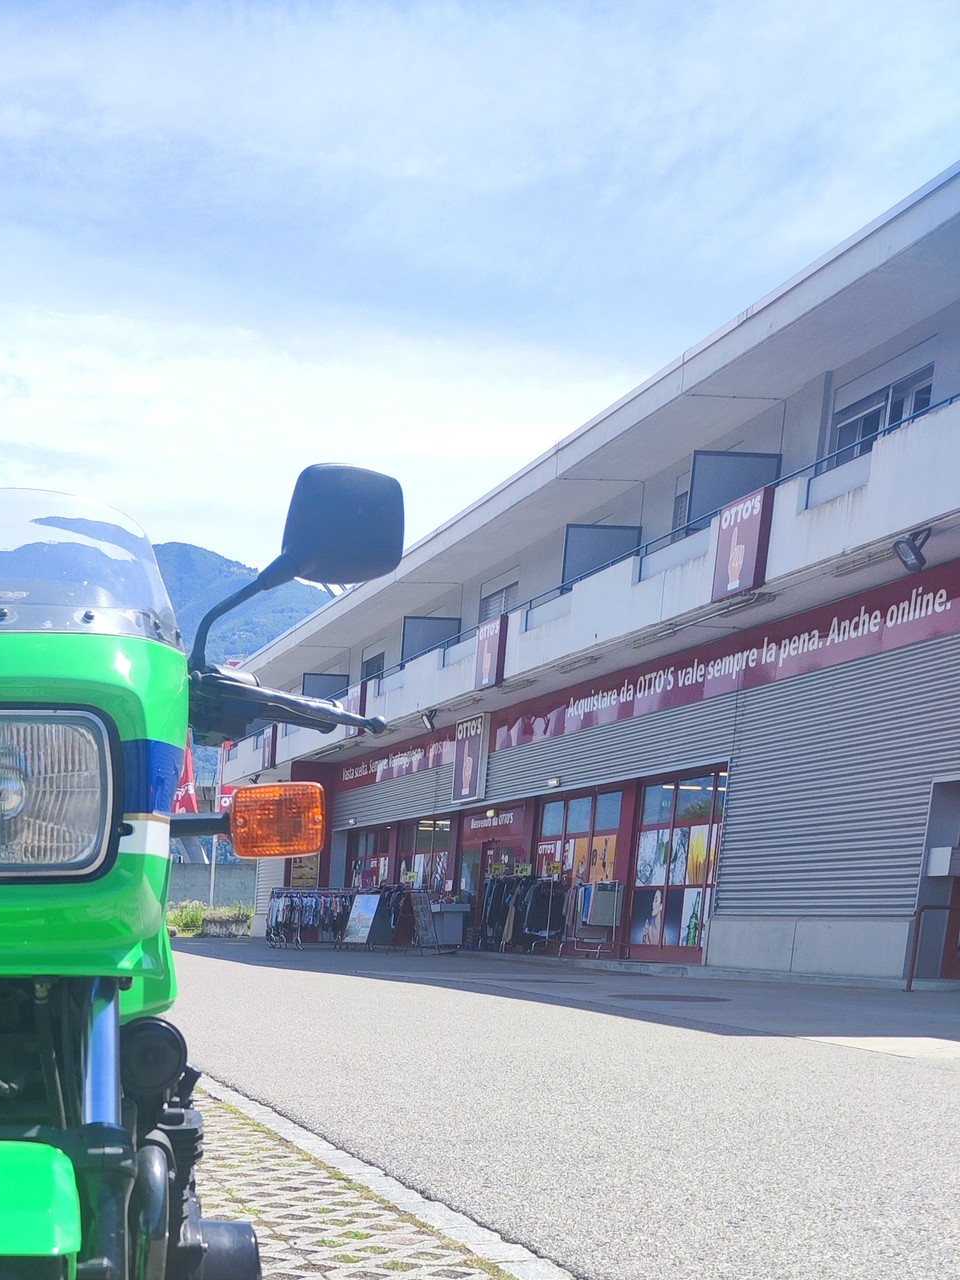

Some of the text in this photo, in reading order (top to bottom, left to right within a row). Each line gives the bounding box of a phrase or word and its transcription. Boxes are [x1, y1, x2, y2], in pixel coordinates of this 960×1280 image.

[721, 495, 761, 530] OTTO'S
[479, 619, 500, 641] OTTO'S
[567, 586, 952, 720] Acquistare da OTTO'S vale sempre la pena. Anche online.
[457, 717, 482, 740] OTTO'S
